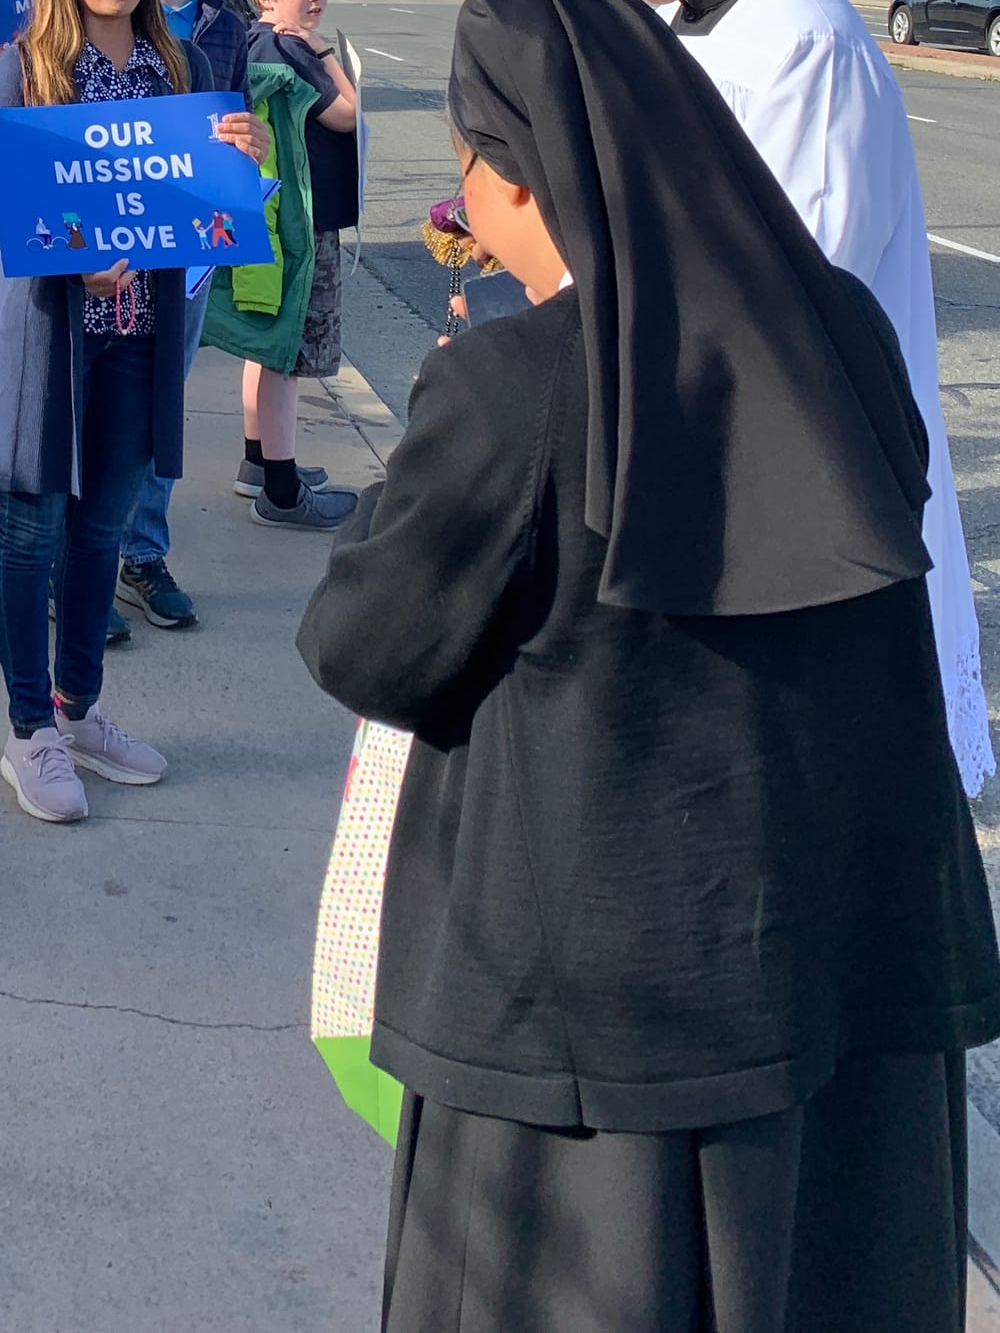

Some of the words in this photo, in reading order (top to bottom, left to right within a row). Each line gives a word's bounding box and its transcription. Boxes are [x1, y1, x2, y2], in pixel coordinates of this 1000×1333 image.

[84, 121, 154, 148] OUR
[54, 153, 193, 184] MISSION
[116, 192, 145, 216] IS
[94, 225, 176, 251] LOVE
